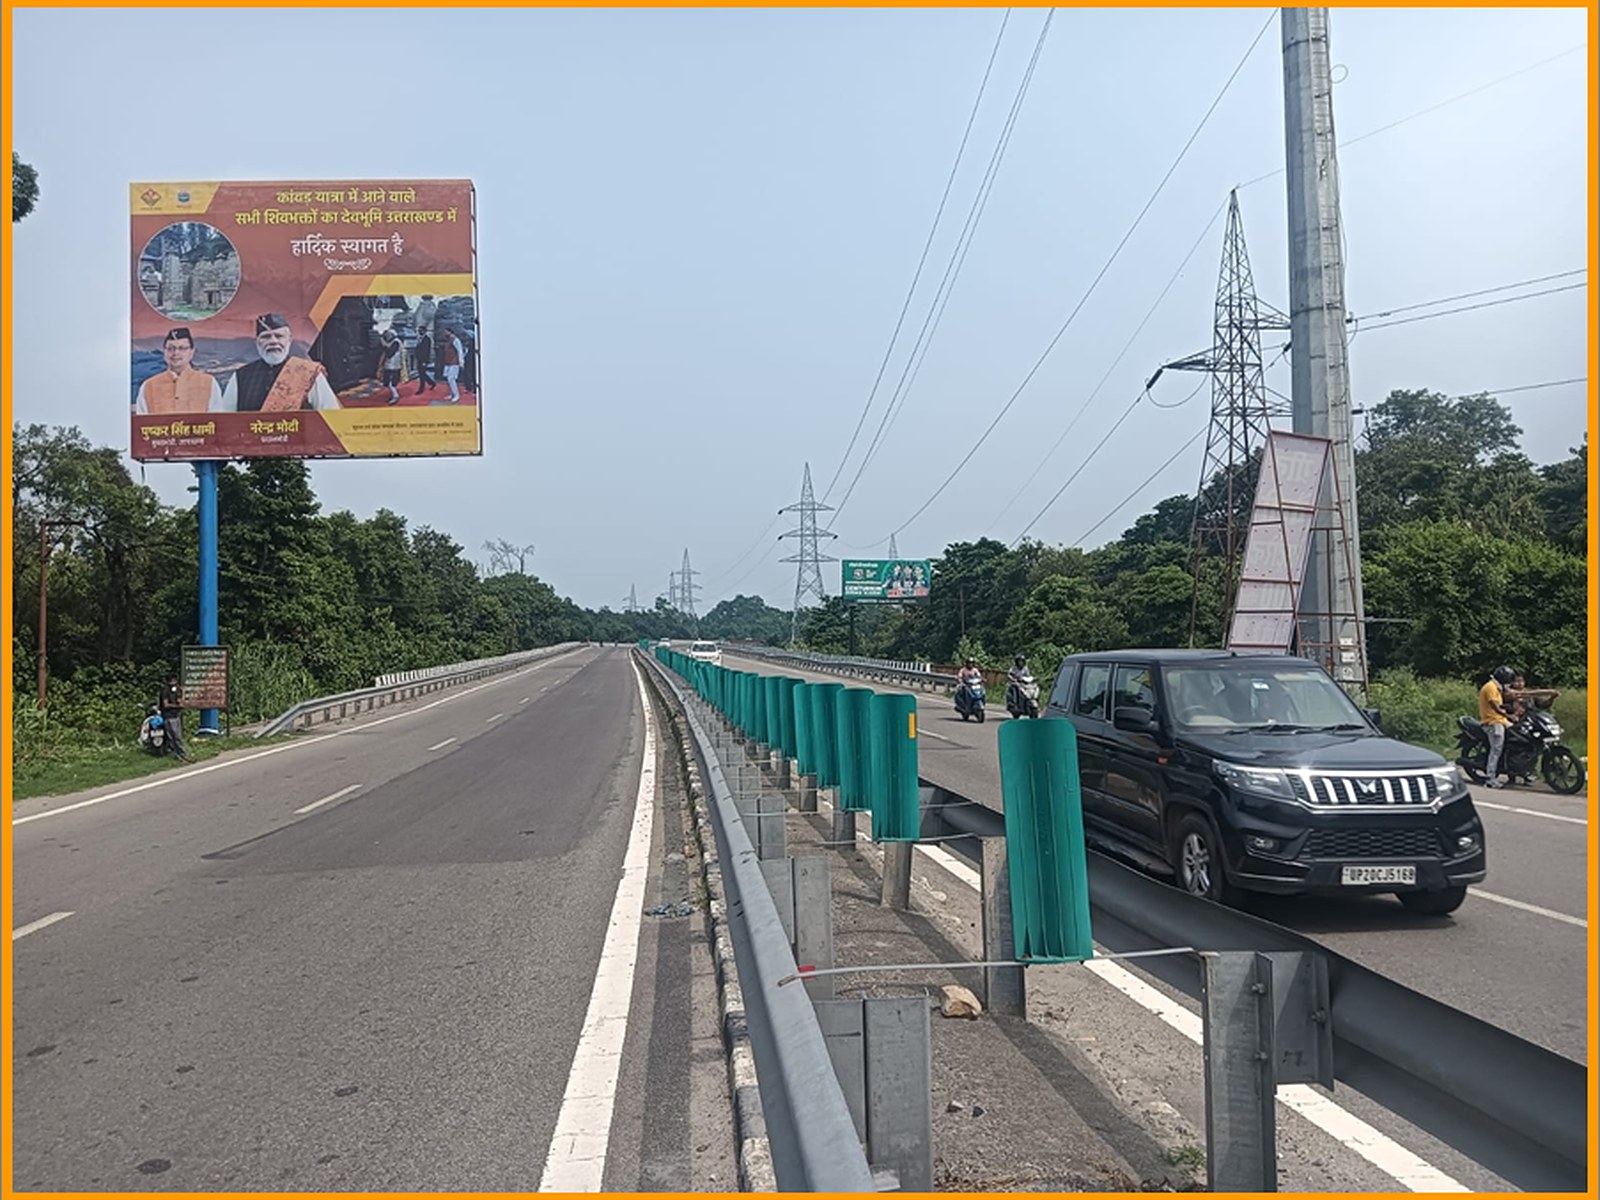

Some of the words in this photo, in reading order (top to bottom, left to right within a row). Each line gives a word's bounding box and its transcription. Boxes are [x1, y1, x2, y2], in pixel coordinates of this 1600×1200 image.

[315, 191, 345, 203] यात्रा
[348, 187, 359, 203] में
[362, 187, 386, 203] आने
[388, 187, 416, 203] वाले
[235, 208, 261, 225] सभी
[264, 207, 318, 225] शिवभक्तों
[321, 211, 339, 224] का
[341, 207, 382, 228] देवभूमि
[385, 210, 444, 224] उत्तराखण्ड
[447, 206, 459, 223] में
[290, 232, 337, 256] हार्दिक
[340, 238, 389, 254] स्वागत
[391, 232, 404, 256] है
[171, 420, 190, 436] सिंह
[192, 421, 216, 435] धामी
[276, 418, 299, 432] मोदी
